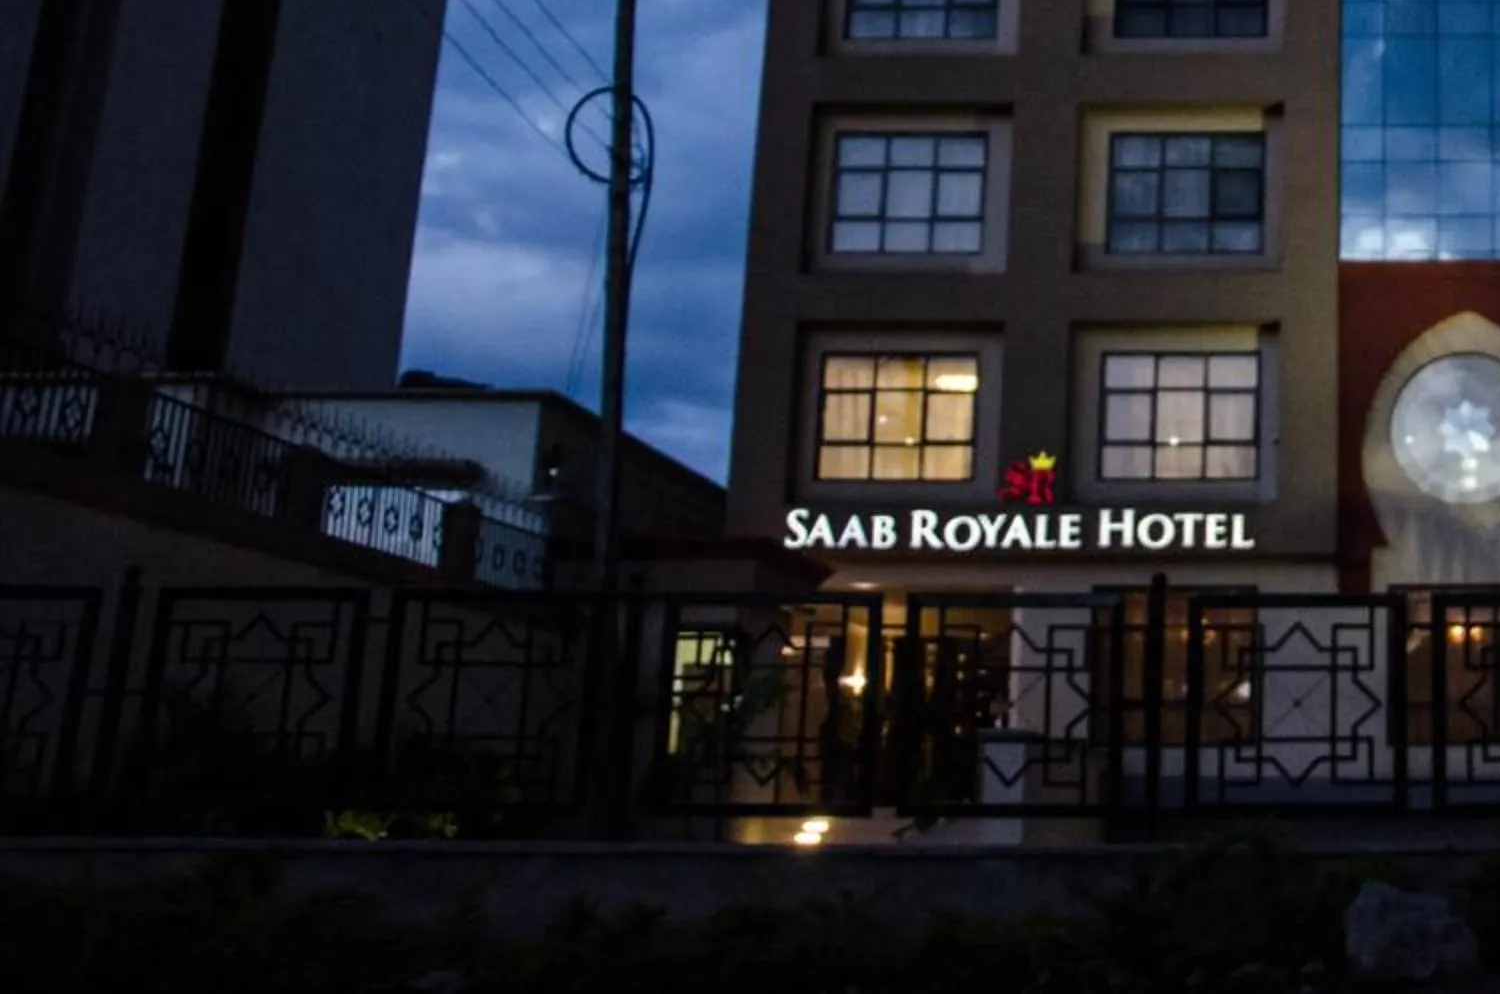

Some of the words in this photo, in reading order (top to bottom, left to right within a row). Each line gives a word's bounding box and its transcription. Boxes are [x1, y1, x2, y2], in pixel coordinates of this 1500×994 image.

[783, 508, 897, 549] SAAB
[908, 508, 1083, 551] ROYALE
[1097, 508, 1255, 549] HOTEL
